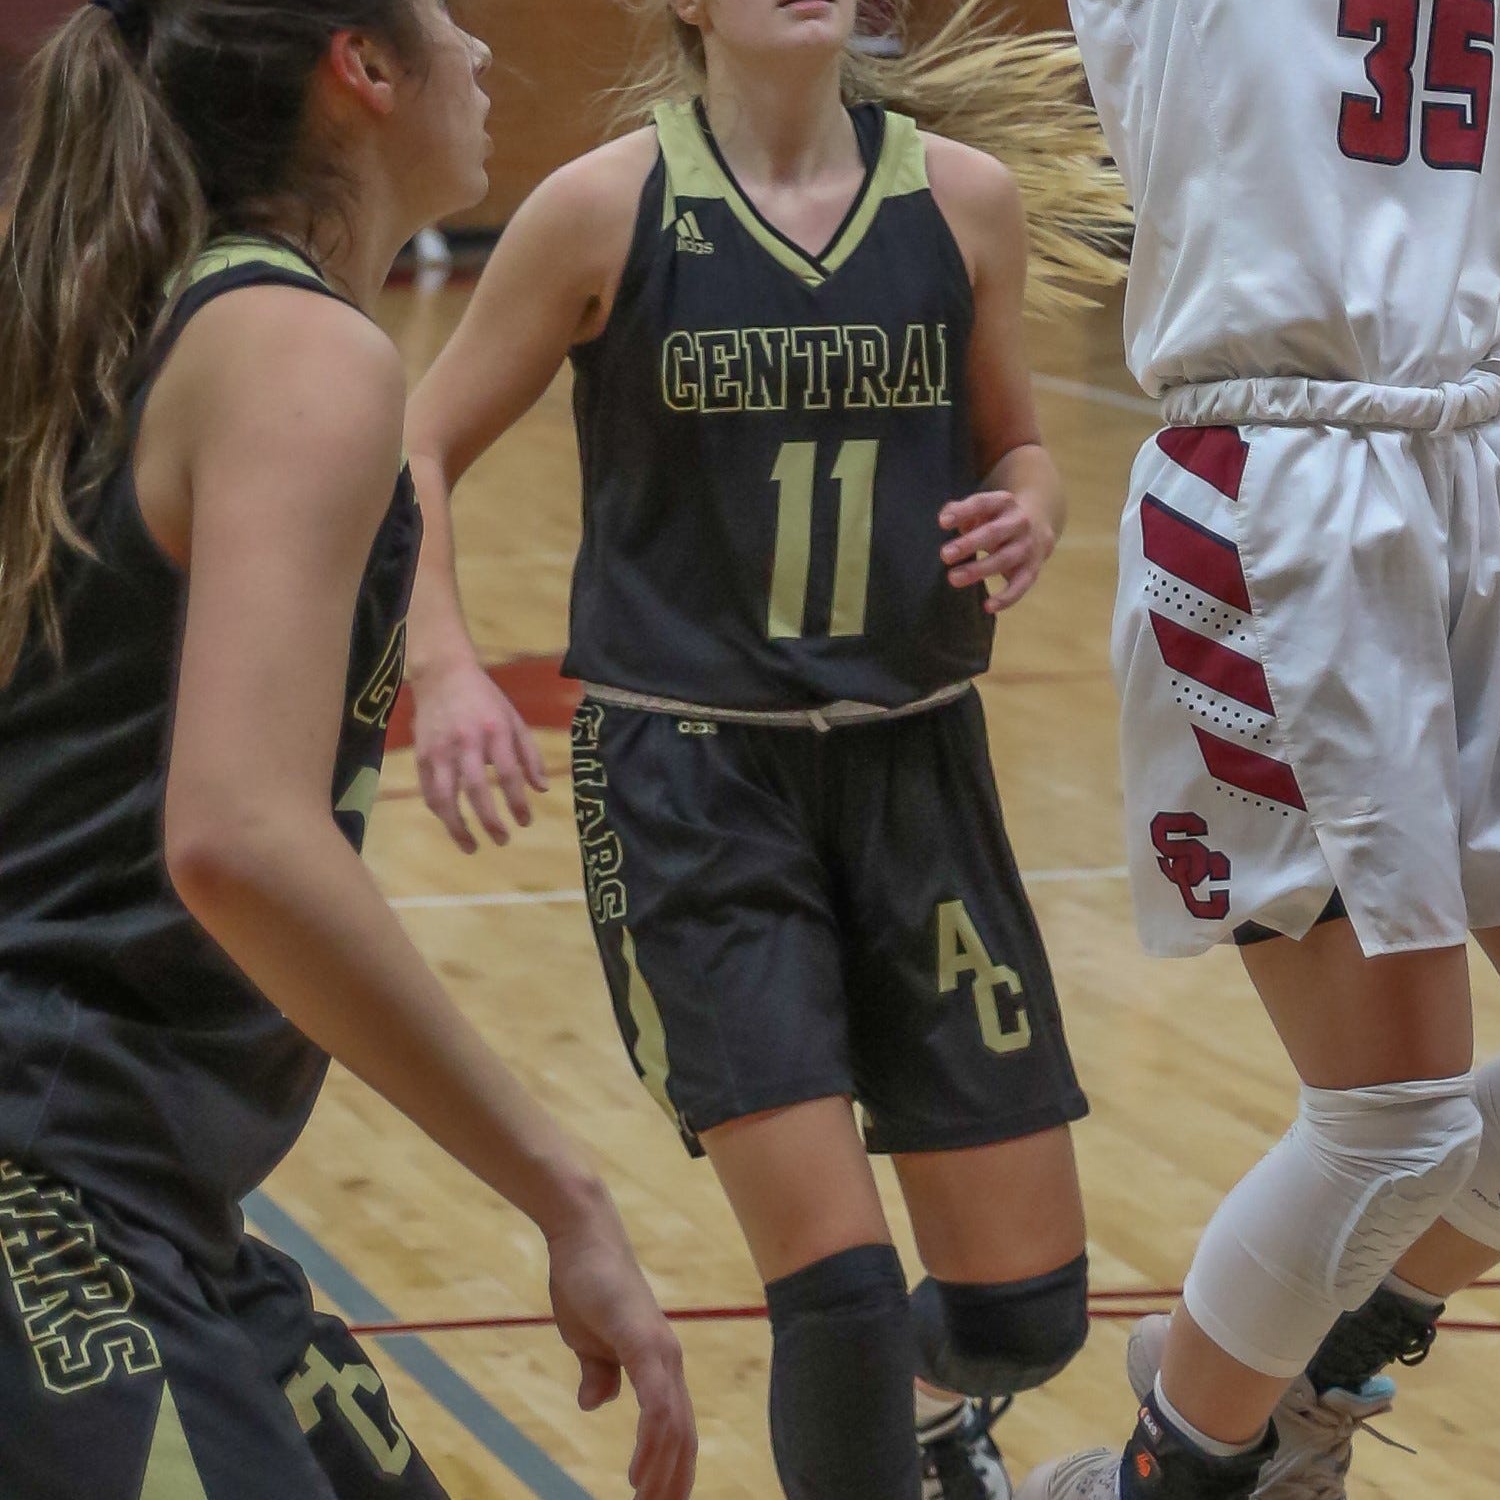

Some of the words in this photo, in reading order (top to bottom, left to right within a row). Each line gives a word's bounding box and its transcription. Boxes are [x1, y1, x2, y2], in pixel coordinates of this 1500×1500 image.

[767, 439, 880, 640] 11
[1150, 810, 1231, 920] SC
[937, 899, 1032, 1054] AC
